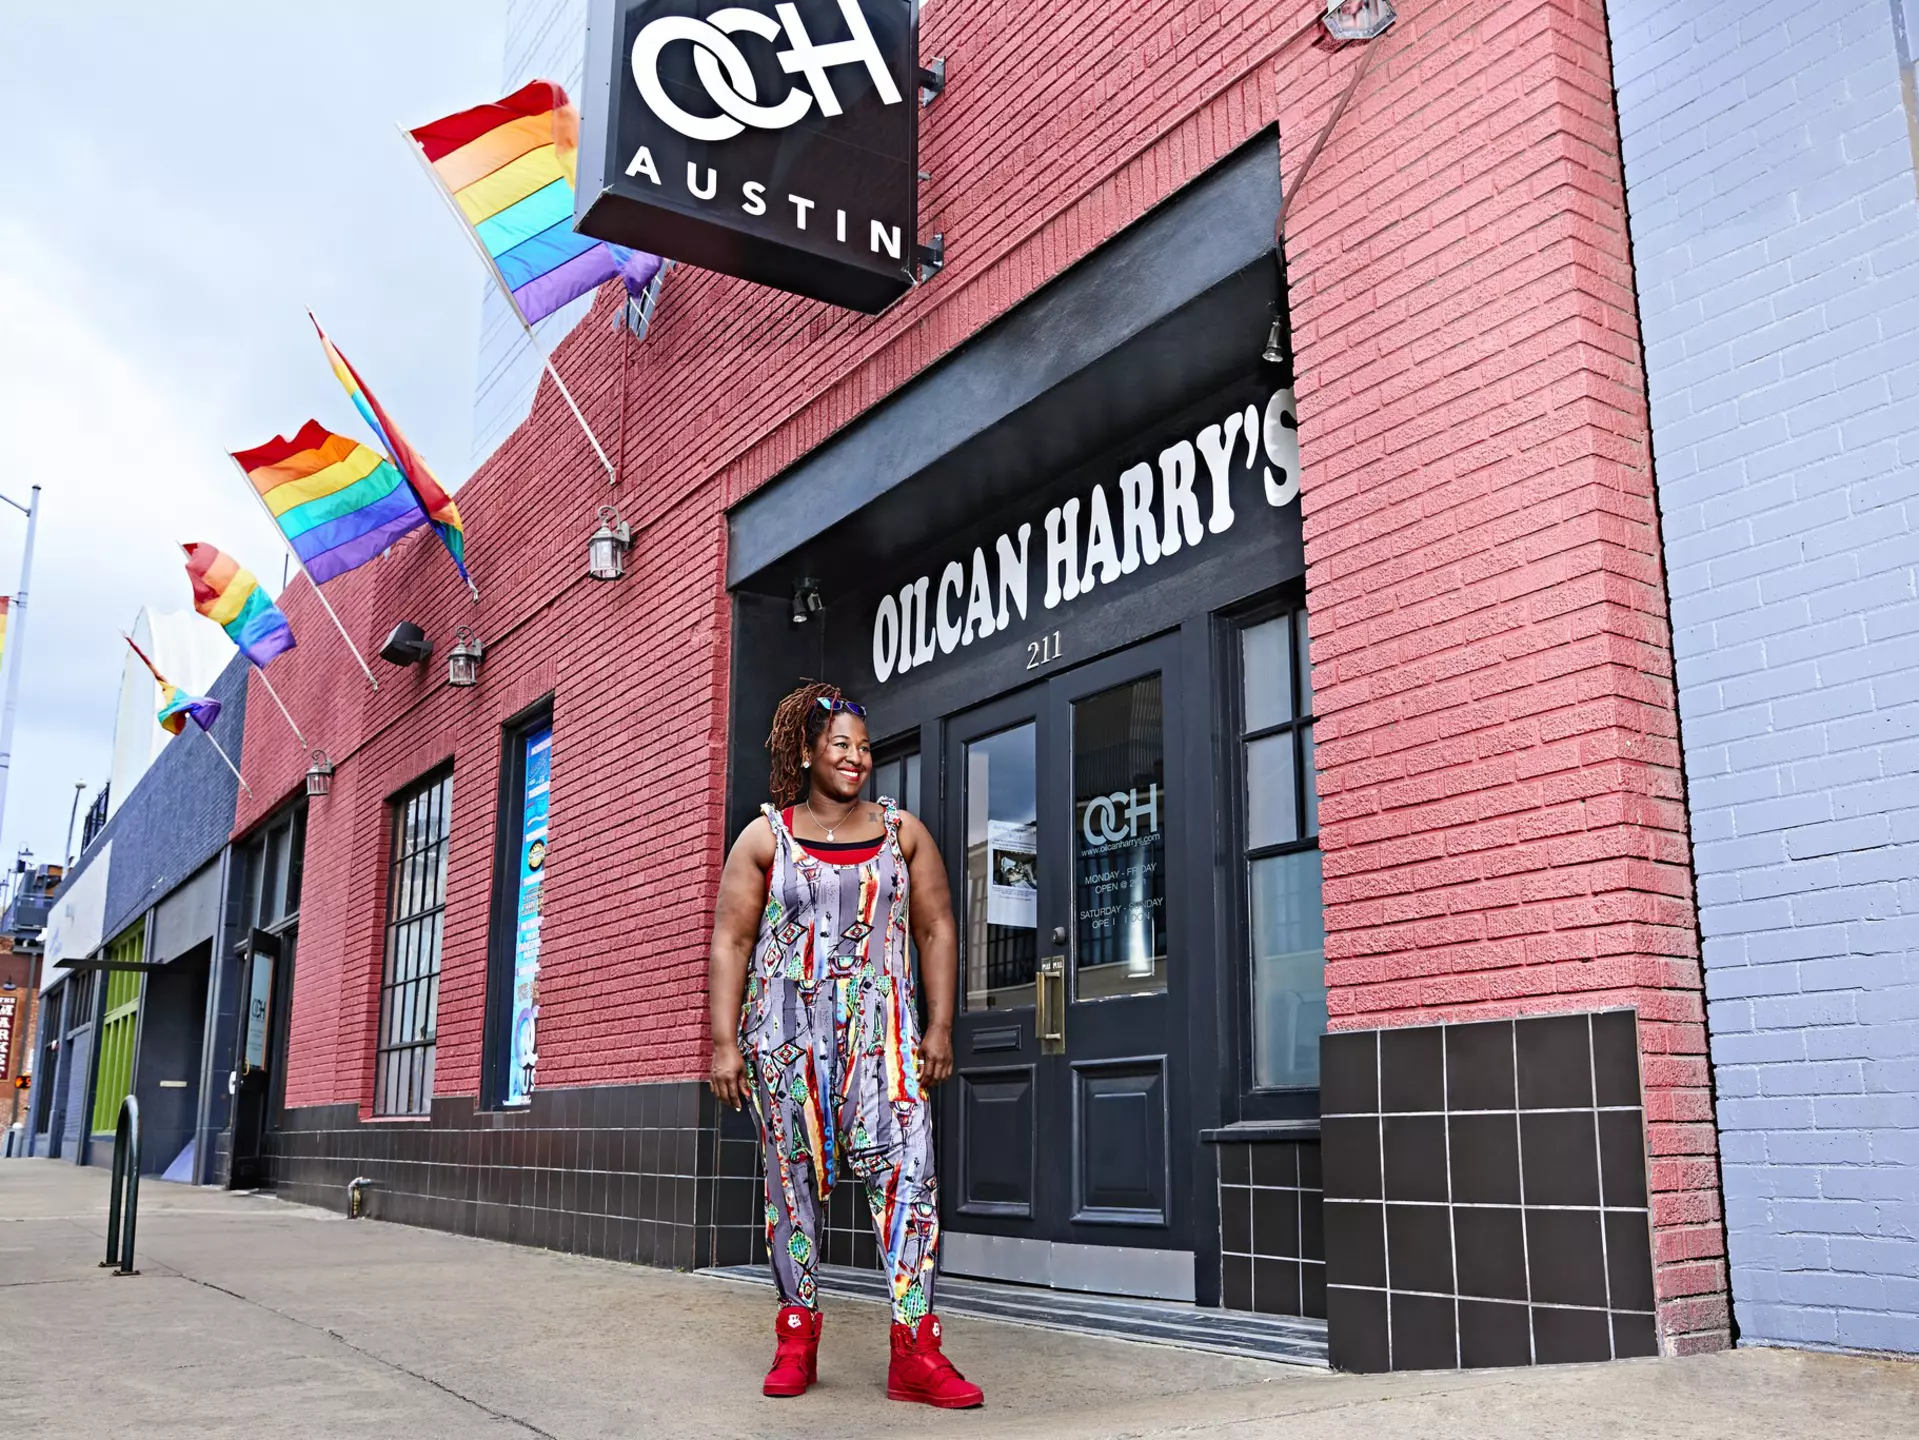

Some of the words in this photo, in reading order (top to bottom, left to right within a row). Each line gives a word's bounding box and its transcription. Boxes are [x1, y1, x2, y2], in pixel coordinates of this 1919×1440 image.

[631, 0, 903, 141] OCH
[625, 146, 901, 259] AUSTIN
[873, 523, 1031, 683] OILCAN
[1043, 388, 1301, 609] HARRY'S
[1026, 630, 1063, 670] 211
[1083, 783, 1158, 846] OCH
[1085, 870, 1120, 885] MONDAY
[1094, 882, 1119, 894] OPEN
[1120, 880, 1128, 890] @
[1080, 905, 1122, 920] SATURDAY
